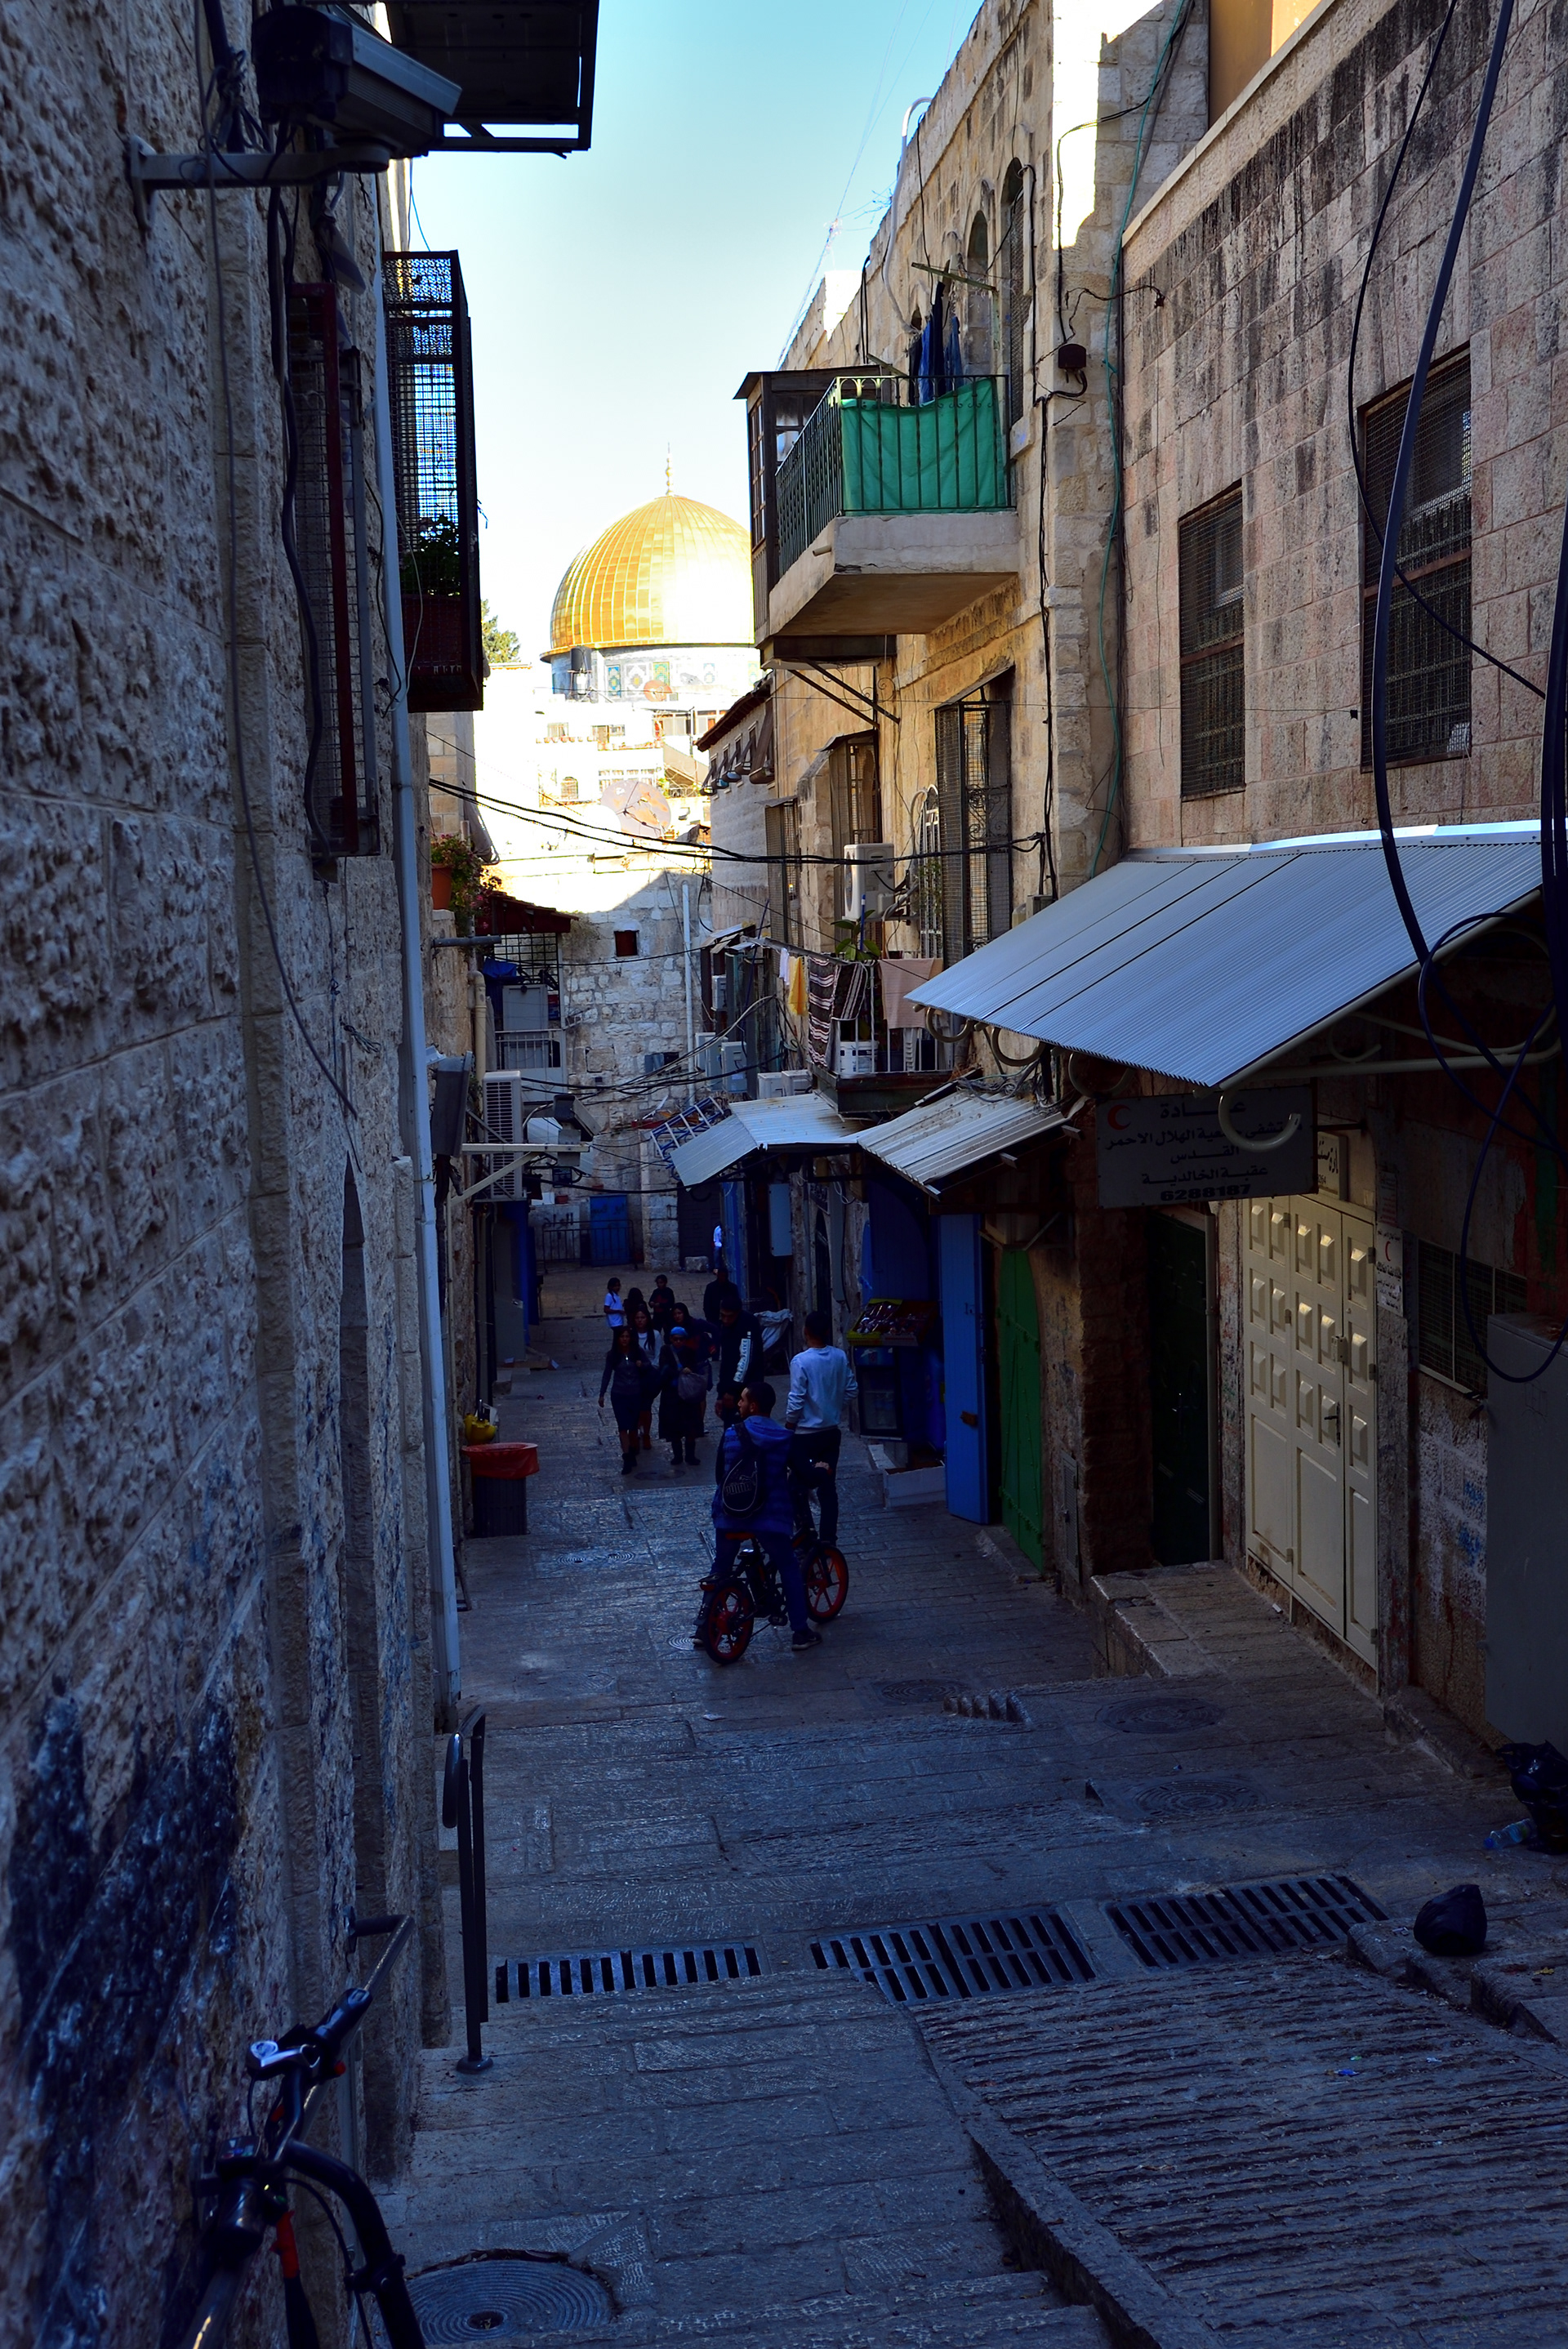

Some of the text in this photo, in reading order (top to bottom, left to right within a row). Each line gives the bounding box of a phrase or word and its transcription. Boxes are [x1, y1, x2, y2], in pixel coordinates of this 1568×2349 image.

[1160, 1102, 1246, 1119] عادة
[1156, 1130, 1195, 1146] الهلال
[1245, 1121, 1303, 1139] متشفى
[1170, 1145, 1239, 1164] القدس
[1143, 1166, 1268, 1184] عقبة الخالدية
[1160, 1184, 1251, 1201] 6288187
